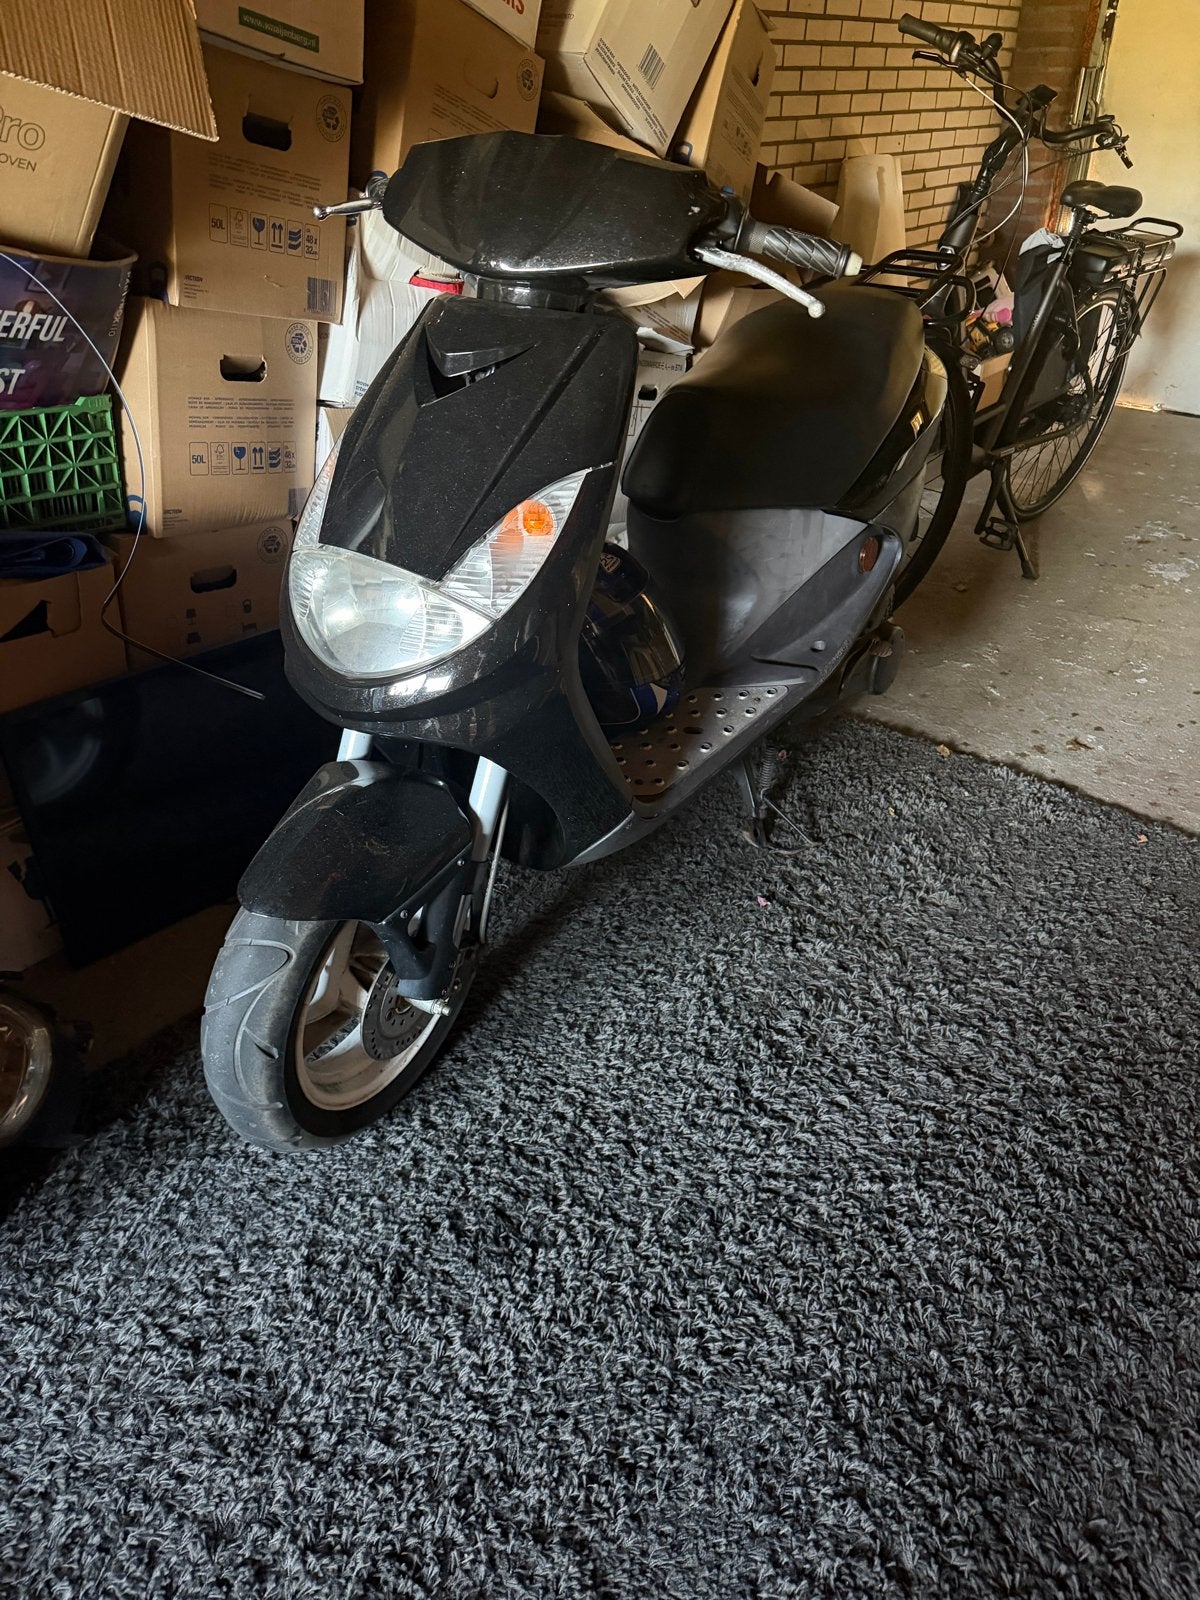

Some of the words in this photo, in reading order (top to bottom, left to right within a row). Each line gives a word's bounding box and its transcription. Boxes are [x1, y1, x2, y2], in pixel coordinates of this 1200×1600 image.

[0, 105, 46, 151] ro
[0, 153, 37, 172] OVEN
[211, 217, 226, 230] 50L
[0, 309, 69, 342] ERFUL
[191, 454, 207, 465] 50L
